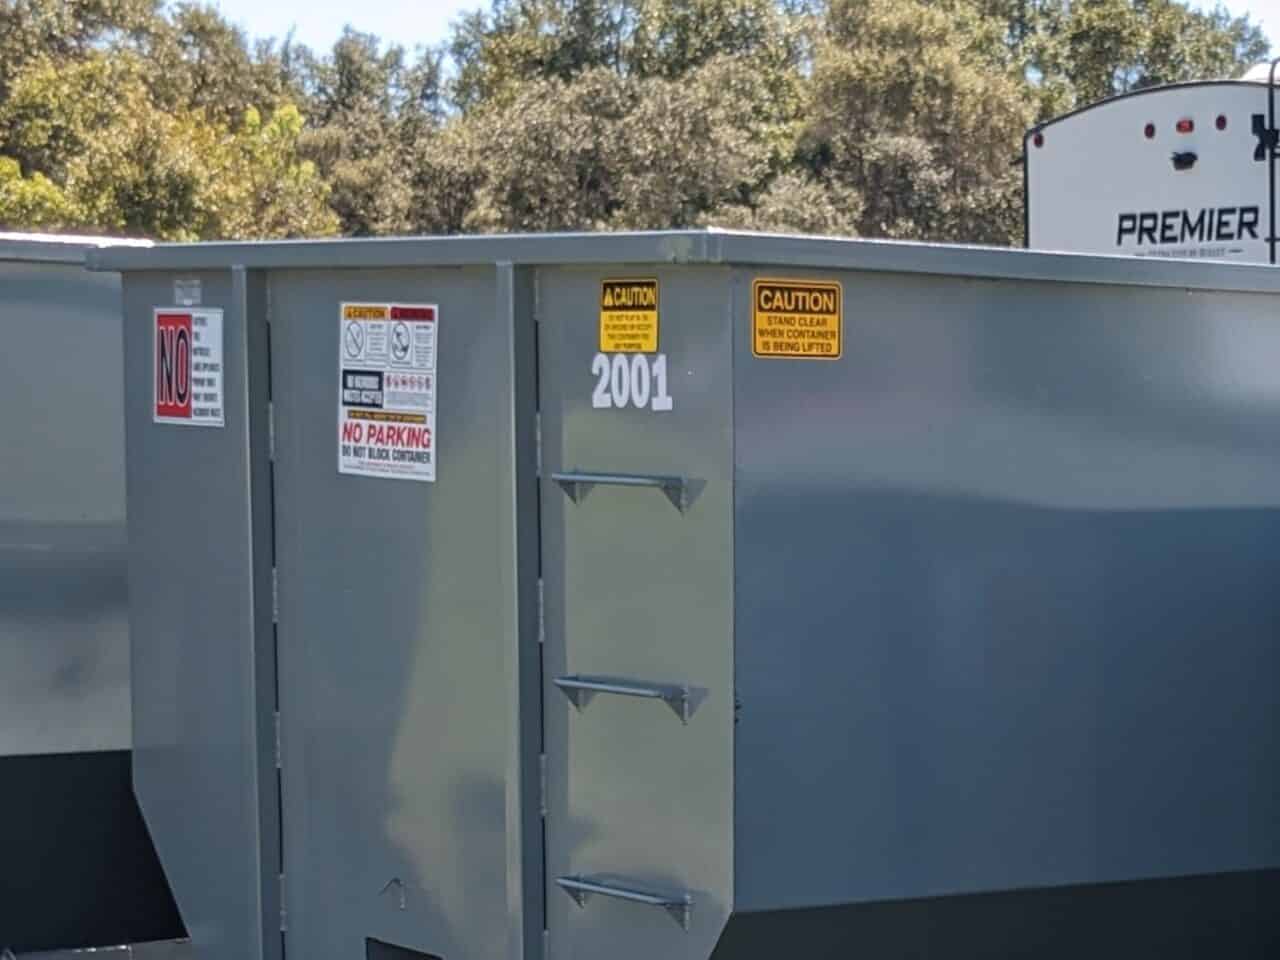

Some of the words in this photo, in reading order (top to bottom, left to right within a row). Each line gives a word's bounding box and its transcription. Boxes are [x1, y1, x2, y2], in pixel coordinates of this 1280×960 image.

[1116, 205, 1259, 246] PREMIER
[614, 287, 656, 305] CAUTION
[760, 290, 834, 311] CAUTION
[768, 316, 795, 326] STAND
[798, 316, 828, 327] CLEAR
[758, 328, 785, 337] WHEN
[786, 329, 836, 340] CONTAINER
[762, 341, 770, 350] IS
[773, 342, 800, 351] BEING
[802, 343, 832, 352] LIFTED
[159, 326, 190, 406] NO
[592, 353, 672, 410] 2001
[343, 423, 362, 443] NO
[367, 425, 431, 449] PARKING
[342, 446, 351, 456] DO
[353, 447, 366, 458] NOT
[368, 448, 390, 460] BLOCK
[392, 449, 431, 463] CONTAINER
